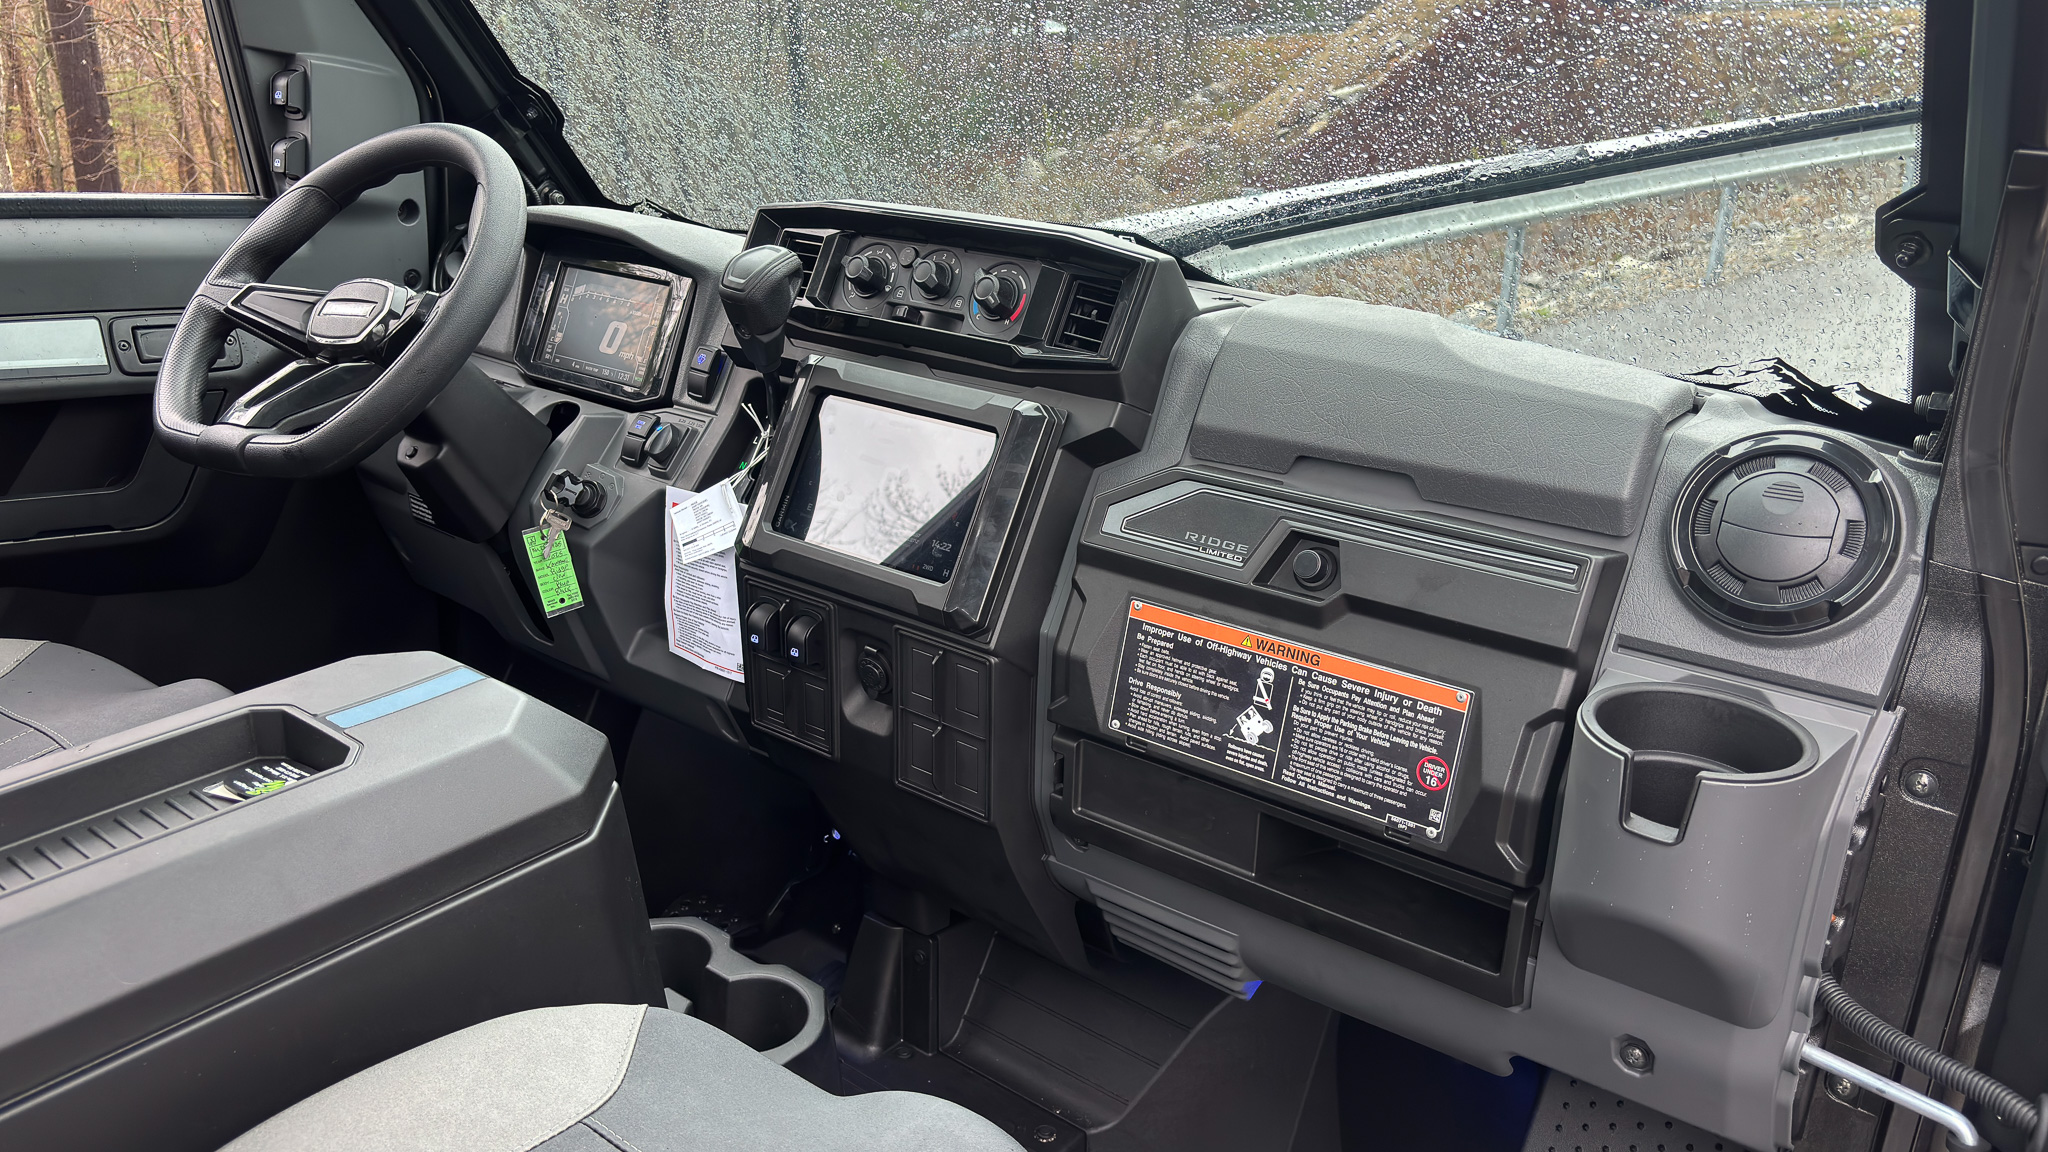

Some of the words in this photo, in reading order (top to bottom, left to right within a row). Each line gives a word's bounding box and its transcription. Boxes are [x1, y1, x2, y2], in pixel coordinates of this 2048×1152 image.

[560, 294, 569, 304] H
[599, 320, 628, 355] 0
[618, 351, 634, 361] mph
[739, 462, 748, 470] N
[776, 495, 790, 528] GARMIN
[932, 540, 952, 552] 14:22
[1185, 532, 1249, 554] RIDGE
[1200, 547, 1243, 562] LIMITED
[922, 564, 934, 572] 2WD
[942, 569, 950, 578] H
[1136, 632, 1145, 641] Be
[1146, 635, 1174, 650] Prepared
[1255, 638, 1321, 667] WARNING
[1142, 622, 1175, 639] Improper
[1177, 632, 1192, 644] Use
[1194, 638, 1204, 647] of
[1206, 641, 1252, 663] Off-Highway
[1255, 654, 1288, 672] Vehicles
[1291, 665, 1308, 677] Can
[1311, 671, 1338, 686] Cause
[1341, 679, 1370, 695] Severe
[1373, 688, 1399, 705] Injury
[1402, 698, 1413, 707] or
[1416, 700, 1443, 716] Death
[1128, 676, 1144, 687] Drive
[1145, 681, 1182, 700] Responsibly
[1297, 678, 1306, 686] Be
[1307, 680, 1320, 690] Sure
[1321, 684, 1350, 699] Occupants
[1350, 693, 1362, 704] Pay
[1362, 697, 1388, 710] Attention
[1388, 705, 1401, 714] and
[1401, 708, 1415, 718] Plan
[1416, 712, 1436, 724] Ahead
[1290, 711, 1312, 724] Require
[1313, 718, 1333, 730] Proper
[1334, 724, 1346, 734] Use
[1353, 729, 1369, 741] Your
[1370, 735, 1391, 748] Vehicle
[1292, 704, 1300, 713] Be
[1299, 706, 1312, 716] Sure
[1311, 710, 1317, 718] to
[1316, 712, 1331, 723] Apply
[1330, 716, 1340, 725] the
[1339, 718, 1358, 732] Parking
[1357, 724, 1373, 735] Brake
[1372, 728, 1390, 740] Before
[1389, 733, 1410, 748] Leaving
[1409, 740, 1419, 749] the
[1418, 742, 1438, 755] Vehicle.
[1422, 768, 1443, 779] UNDER
[1424, 762, 1445, 774] DRIVER
[1282, 768, 1296, 778] Read
[1296, 773, 1316, 785] Owner's
[1317, 780, 1337, 792] Manual.
[1426, 776, 1438, 787] 16
[1281, 774, 1297, 785] Follow
[1297, 780, 1306, 788] All
[1306, 783, 1335, 798] Instructions
[1347, 796, 1372, 810] Warnings.
